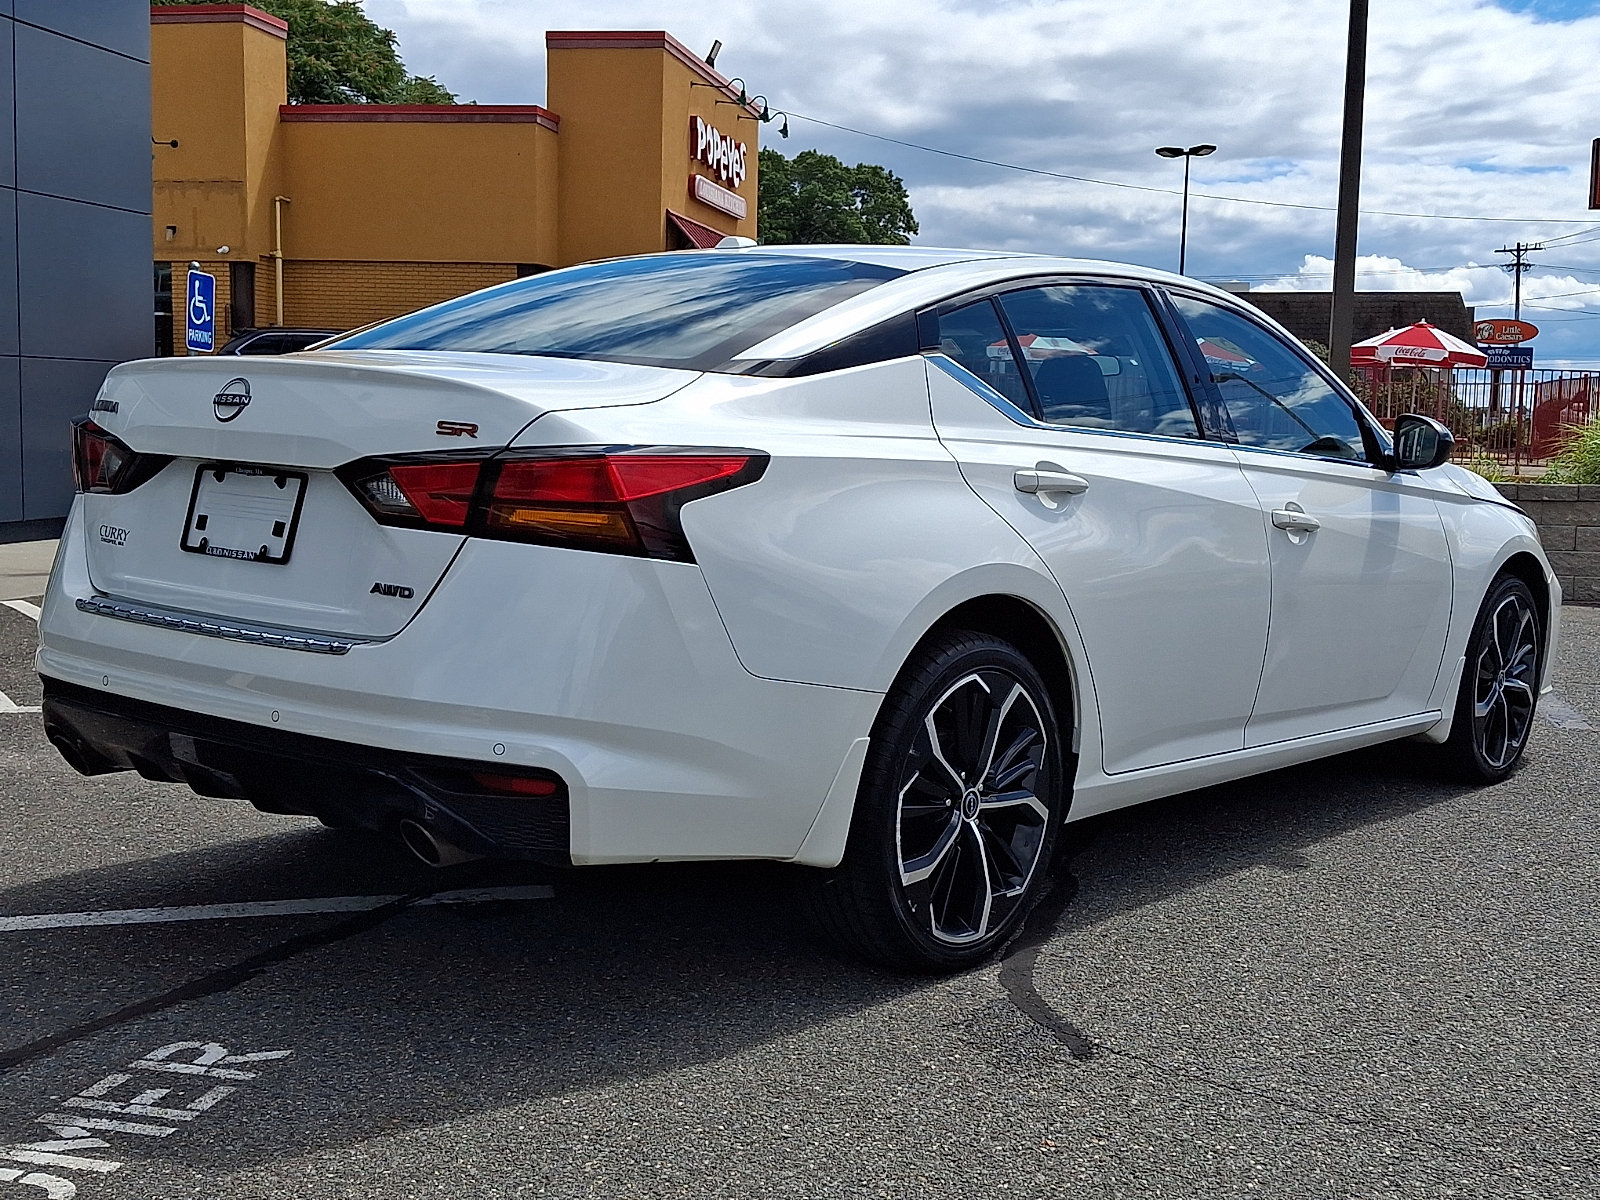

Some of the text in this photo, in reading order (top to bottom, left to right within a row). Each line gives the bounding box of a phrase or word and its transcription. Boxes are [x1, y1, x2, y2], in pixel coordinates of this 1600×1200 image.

[1502, 325, 1521, 334] Little
[188, 329, 212, 344] PARKING
[1495, 333, 1523, 341] Caesars
[1488, 355, 1531, 364] ODONTICS
[214, 394, 250, 406] NISSAN
[435, 420, 479, 439] SR
[100, 525, 130, 541] CURRY
[222, 549, 255, 560] NISSAN
[370, 582, 415, 599] AWD
